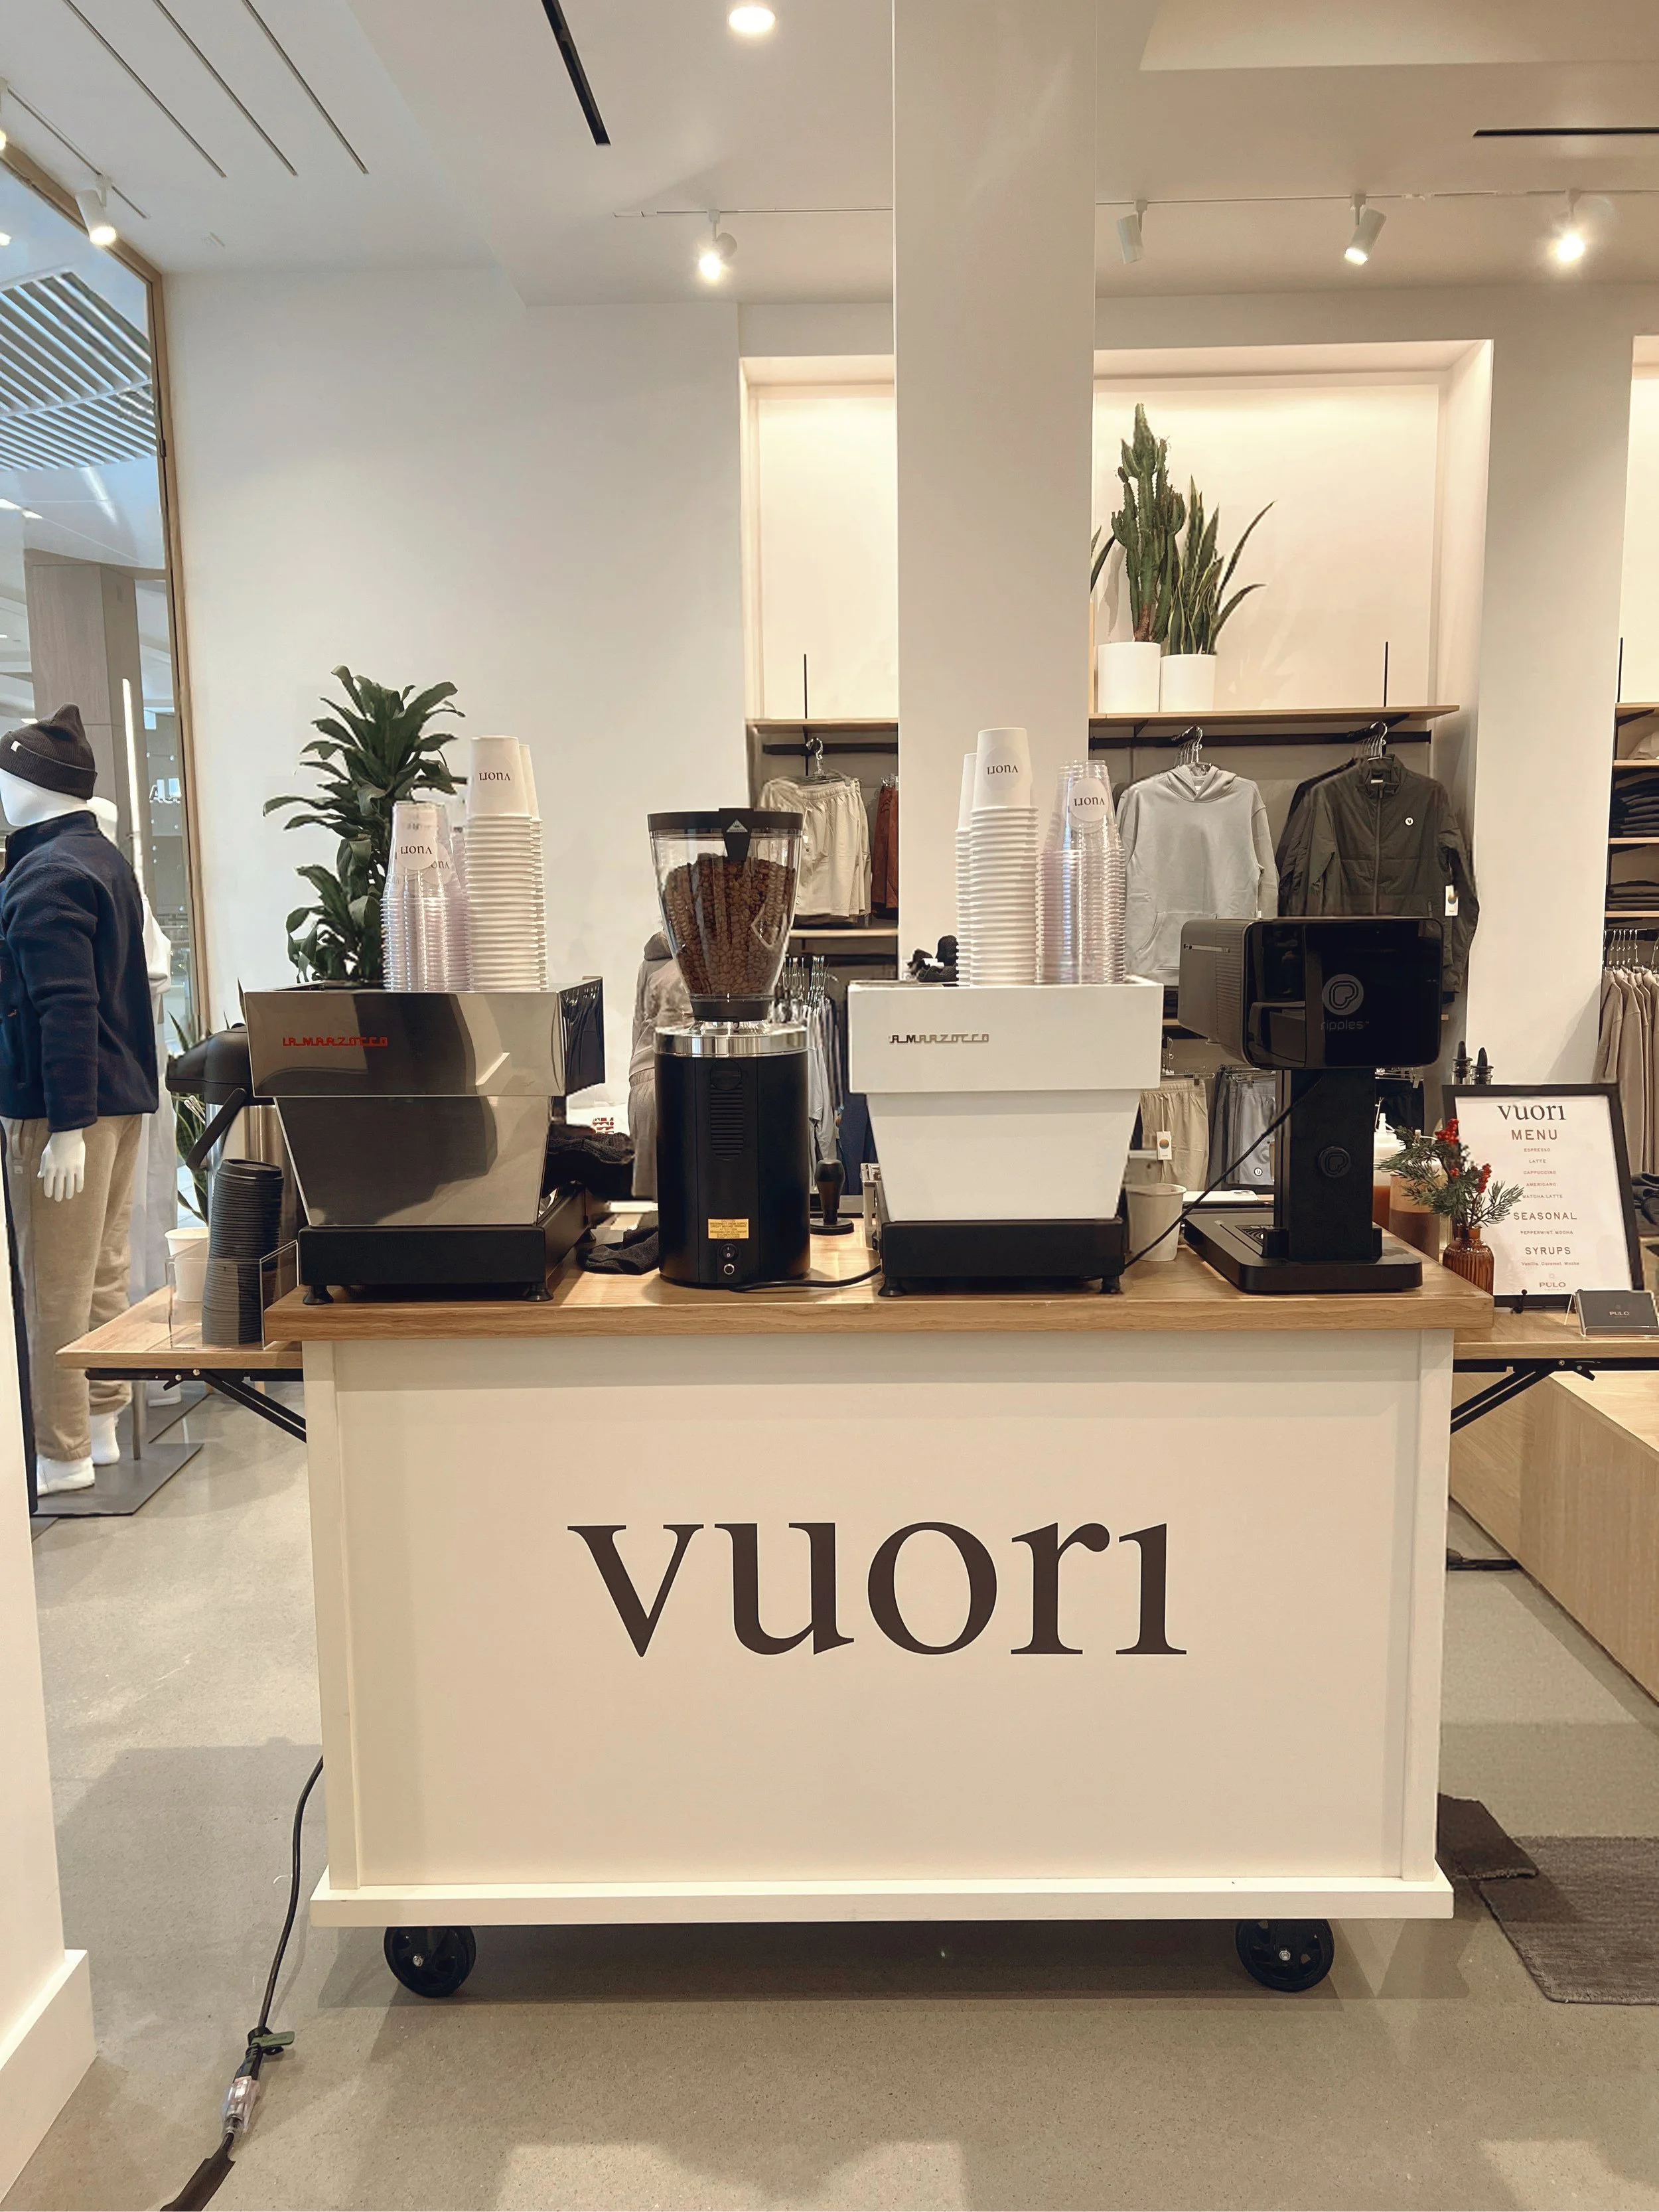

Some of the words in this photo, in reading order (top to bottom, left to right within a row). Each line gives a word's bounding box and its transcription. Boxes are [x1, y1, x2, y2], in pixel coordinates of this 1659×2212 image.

[987, 764, 1019, 775] vuori
[478, 772, 511, 781] vuori
[1074, 796, 1105, 807] vuori
[400, 845, 433, 855] vuori
[431, 860, 450, 869] vuo
[1497, 1104, 1567, 1121] vuori
[1511, 1129, 1557, 1141] MENU
[1513, 1212, 1577, 1220] SEASONAL
[1525, 1246, 1571, 1255] SYRUPS
[567, 1521, 1188, 1658] vuori
